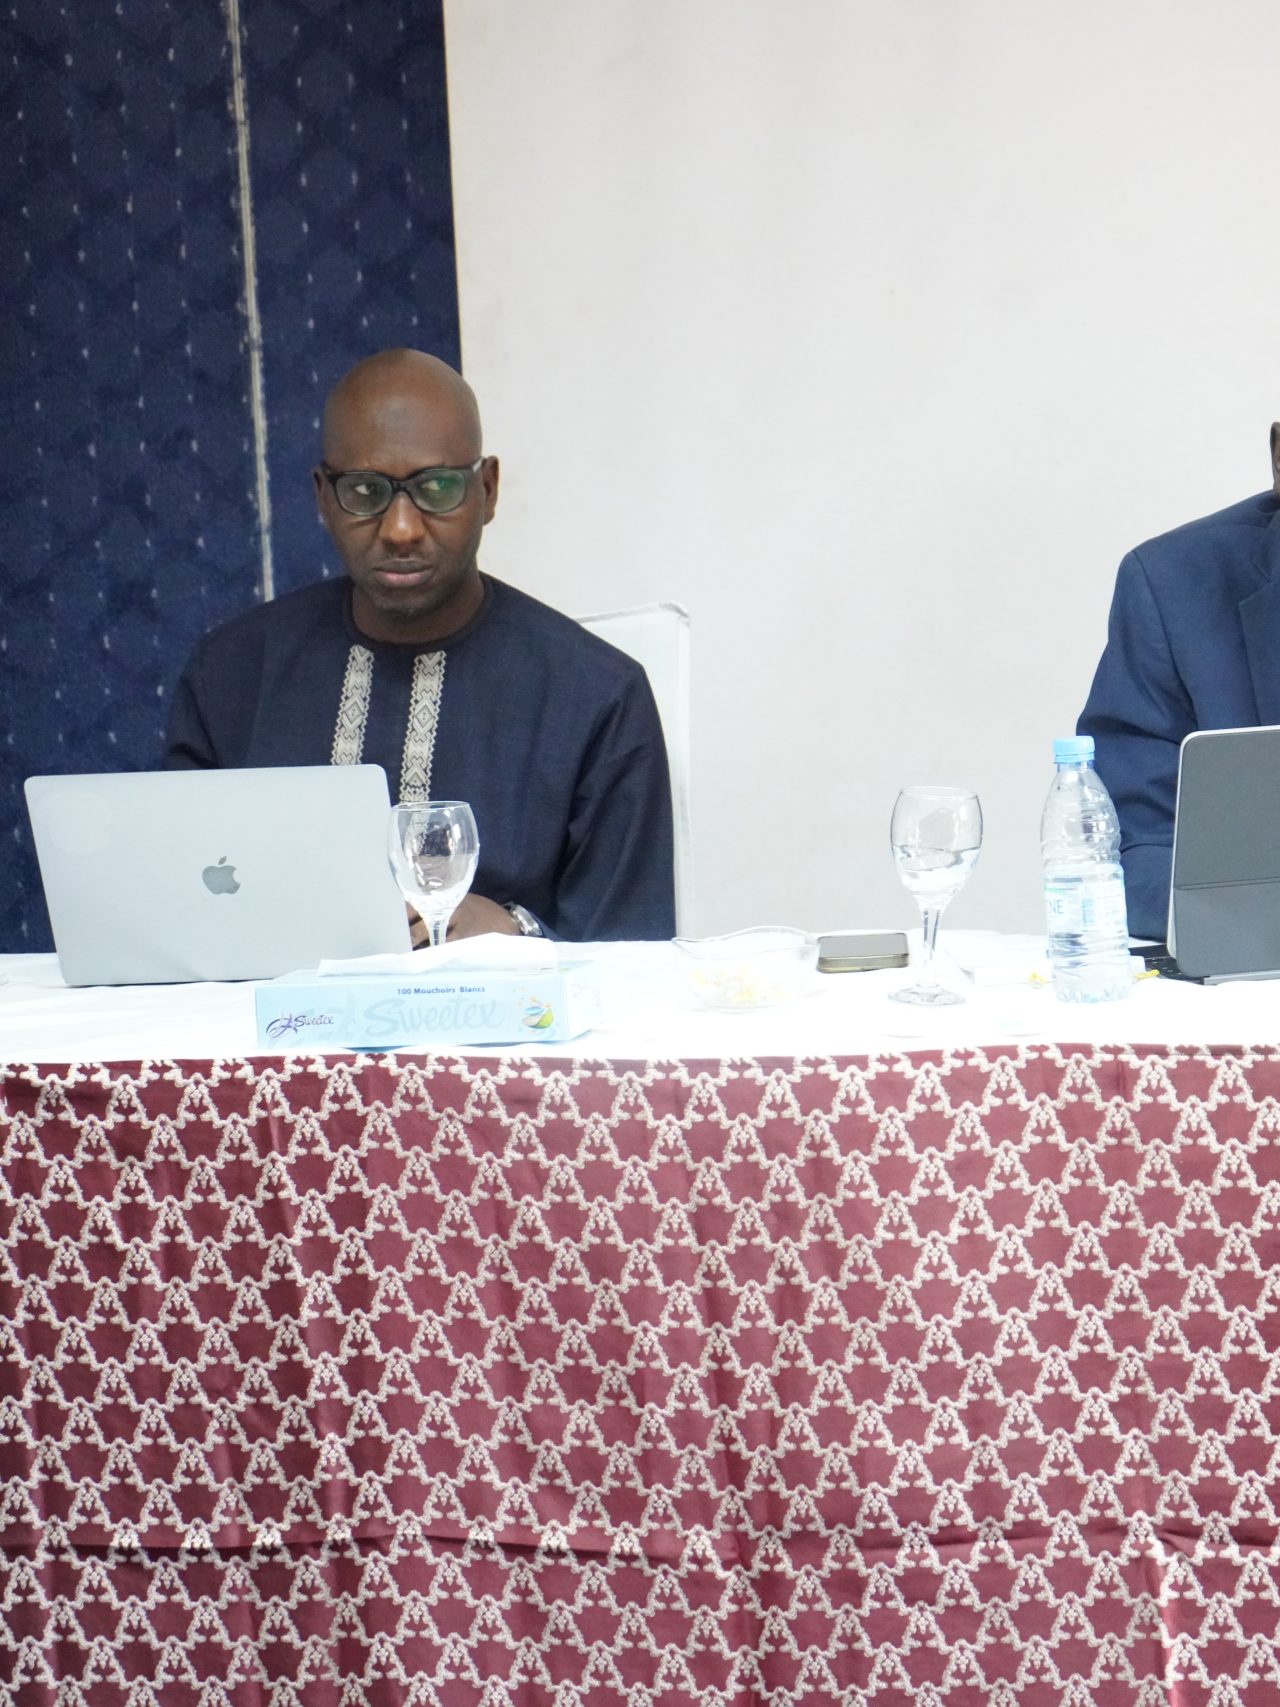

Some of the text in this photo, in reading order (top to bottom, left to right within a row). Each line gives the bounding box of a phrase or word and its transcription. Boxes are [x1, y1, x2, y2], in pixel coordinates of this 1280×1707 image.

[397, 985, 486, 996] 100 Mouchoirs Blancs
[363, 996, 504, 1038] Sweetex
